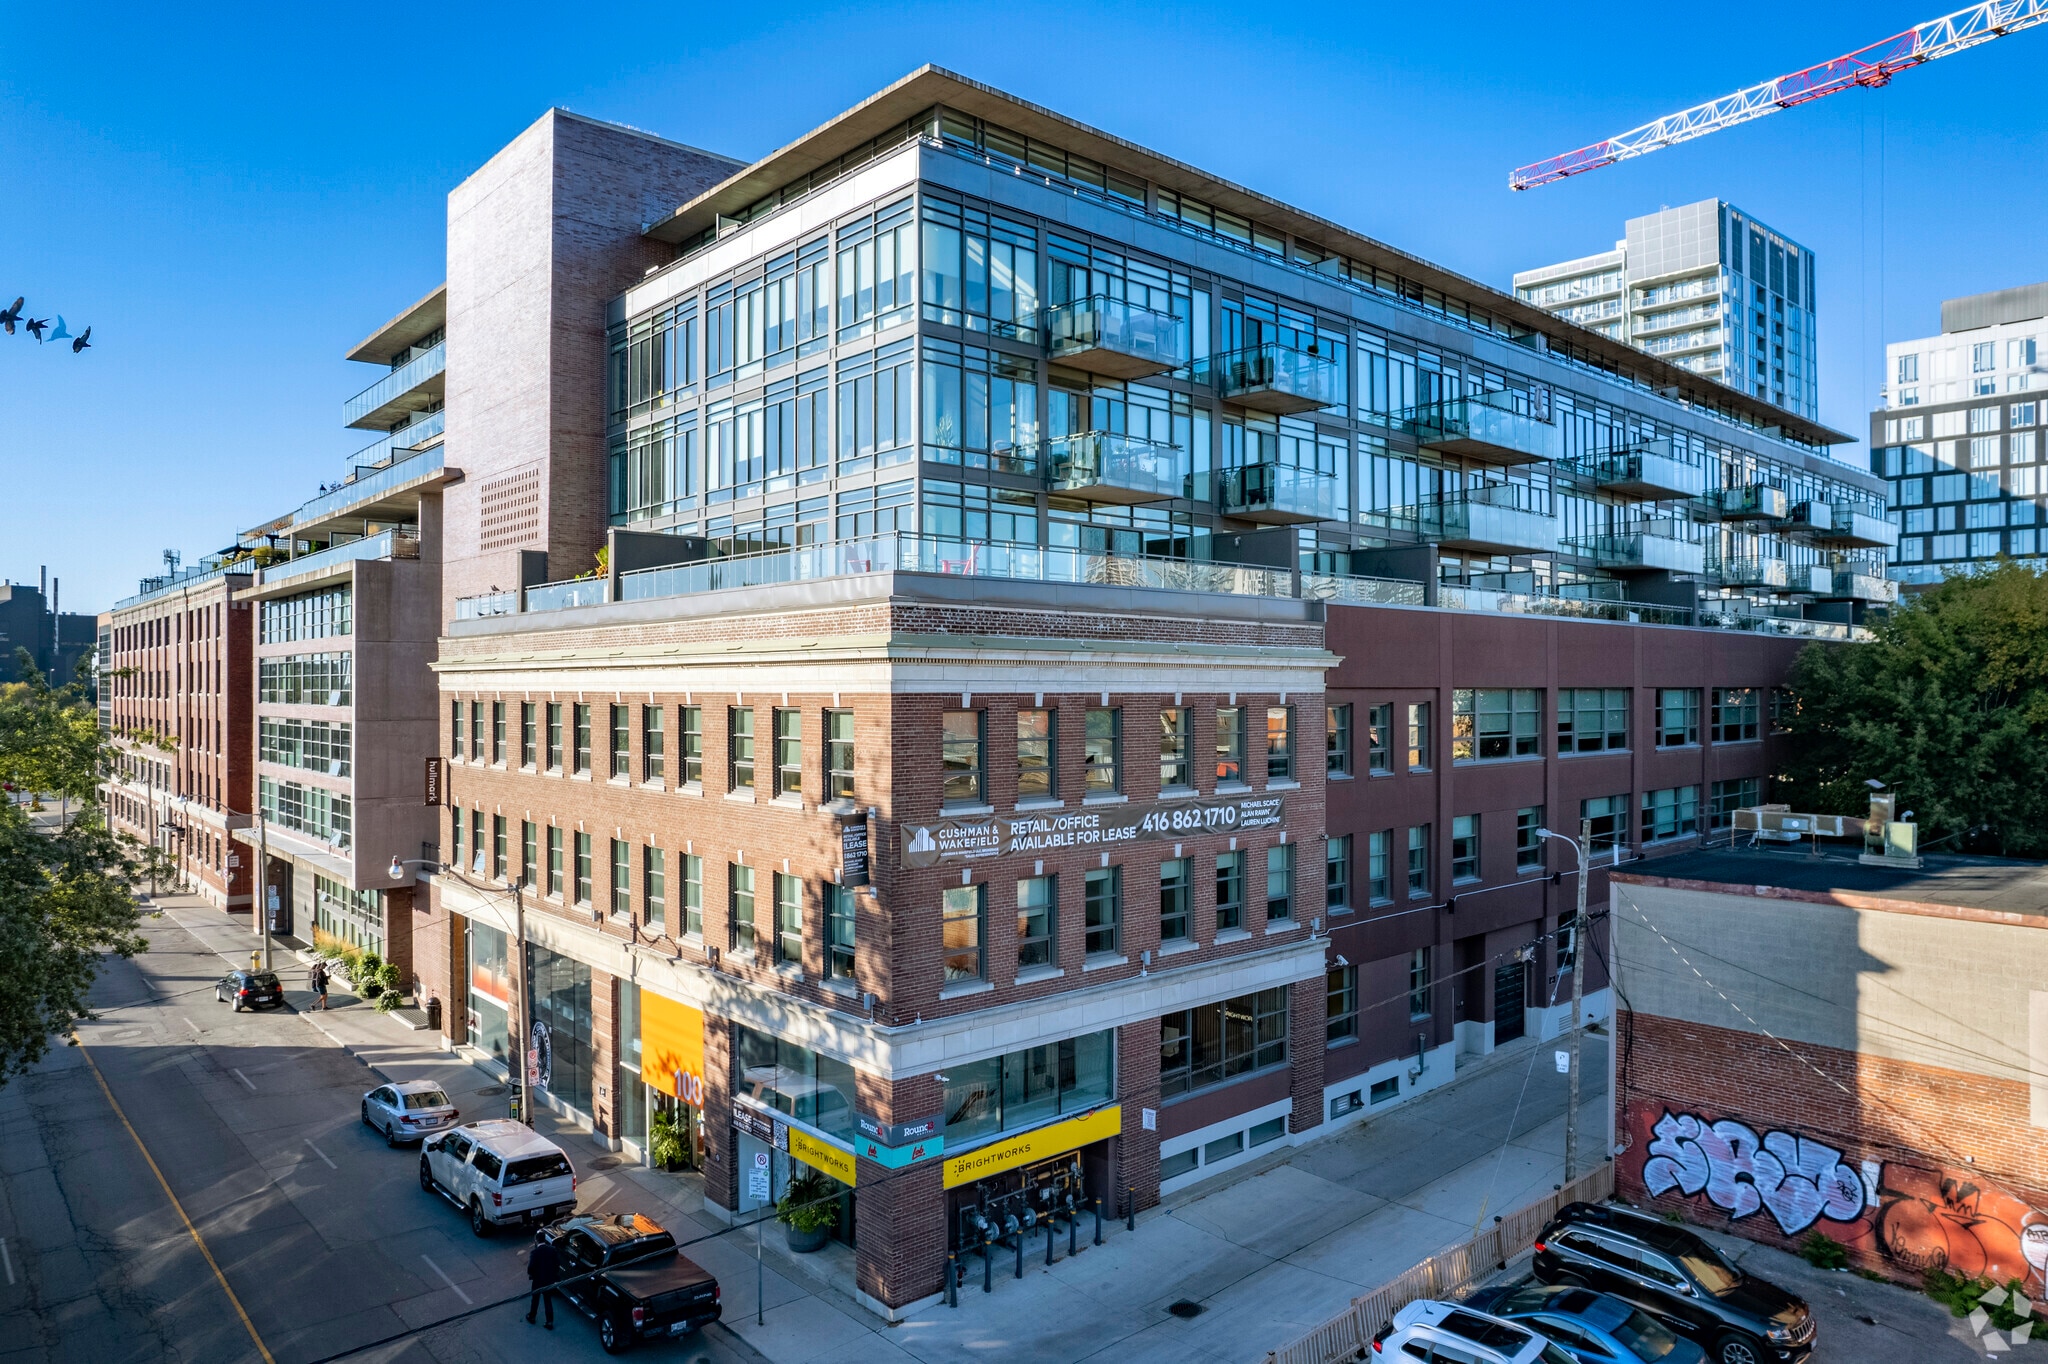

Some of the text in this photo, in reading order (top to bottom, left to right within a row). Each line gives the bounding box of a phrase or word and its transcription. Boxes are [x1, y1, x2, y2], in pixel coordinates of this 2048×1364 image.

[429, 761, 438, 802] hullmark
[1241, 800, 1262, 809] MICHAEL
[1241, 810, 1255, 818] ALAN
[1010, 815, 1100, 836] RETAIL/OFFICE
[1142, 806, 1236, 832] 416 862 1710
[939, 825, 999, 839] CUSHMAN &
[939, 836, 999, 850] WAKEFIELD
[1010, 826, 1137, 852] AVAILABLE FOR LEASE
[845, 840, 867, 849] LEASE
[674, 1068, 703, 1105] 100
[797, 1141, 849, 1172] BRIGHTWORKS
[958, 1144, 1031, 1173] BRIGHTWORKS
